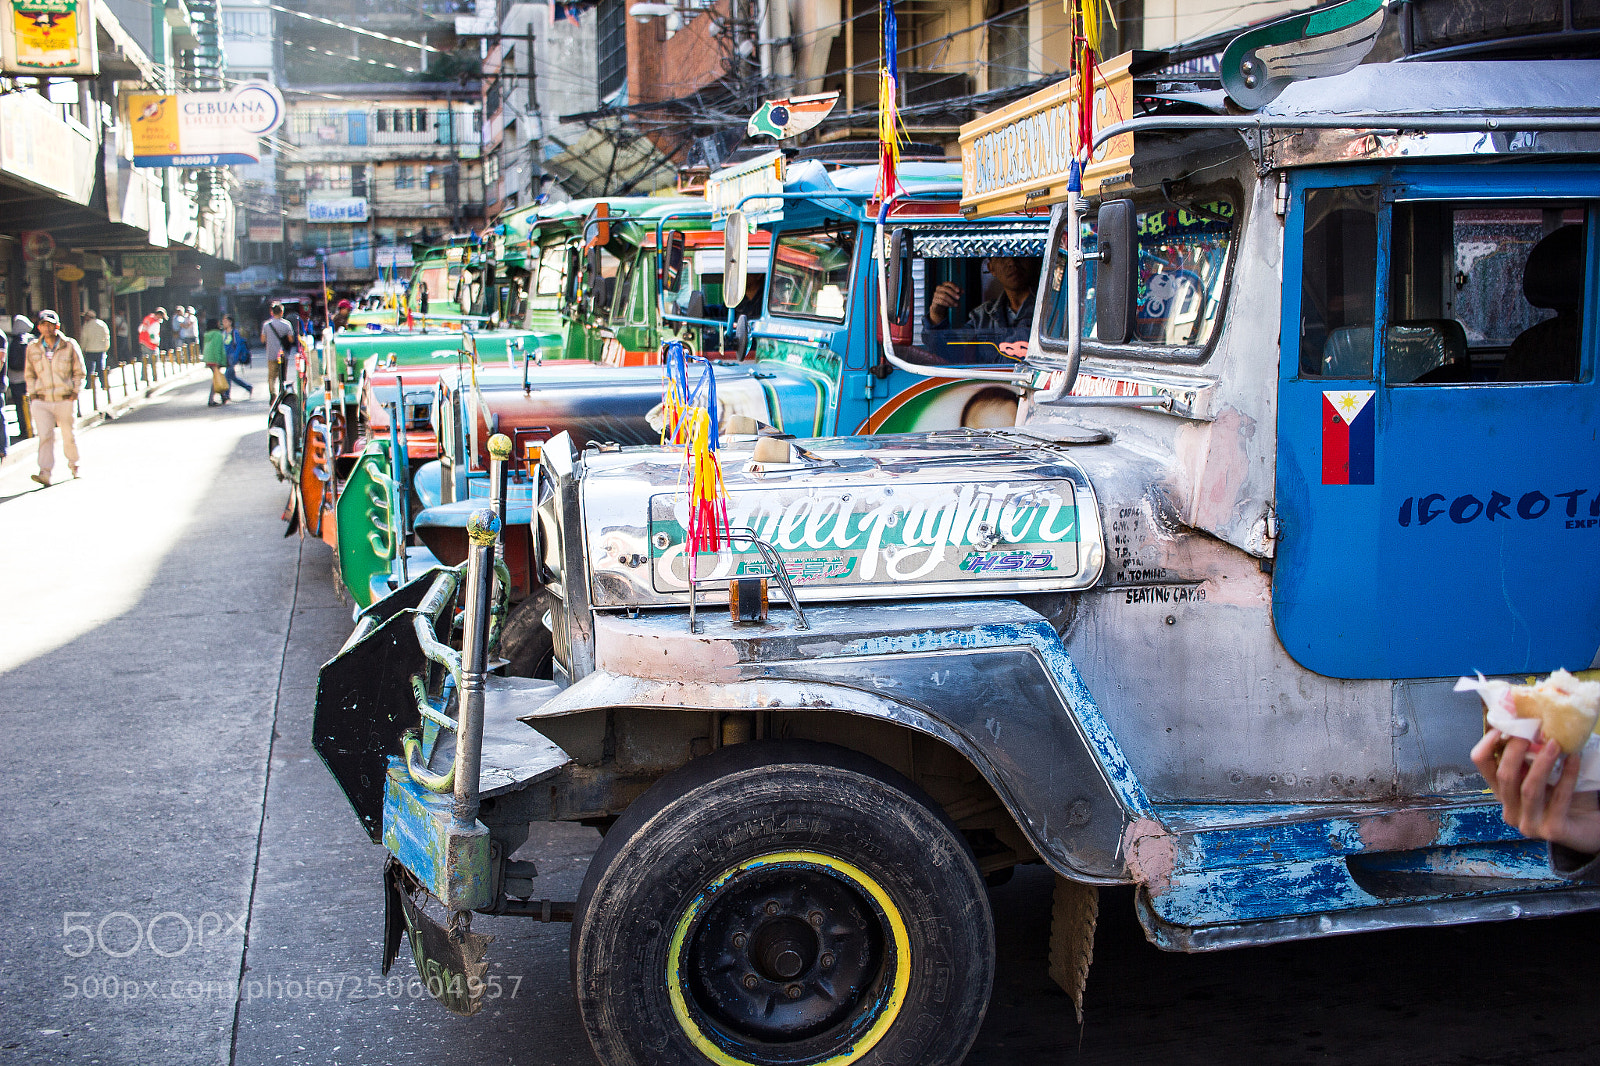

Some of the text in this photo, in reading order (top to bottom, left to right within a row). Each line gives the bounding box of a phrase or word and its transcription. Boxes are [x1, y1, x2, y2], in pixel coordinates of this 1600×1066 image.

[184, 101, 265, 115] CEBUANA
[185, 114, 265, 125] LHUILLIER
[172, 154, 219, 166] BAGUIO 7
[1565, 519, 1600, 530] EXP
[657, 482, 1075, 589] Street Fighter
[966, 554, 1053, 571] HSD
[1125, 586, 1171, 604] SEATING
